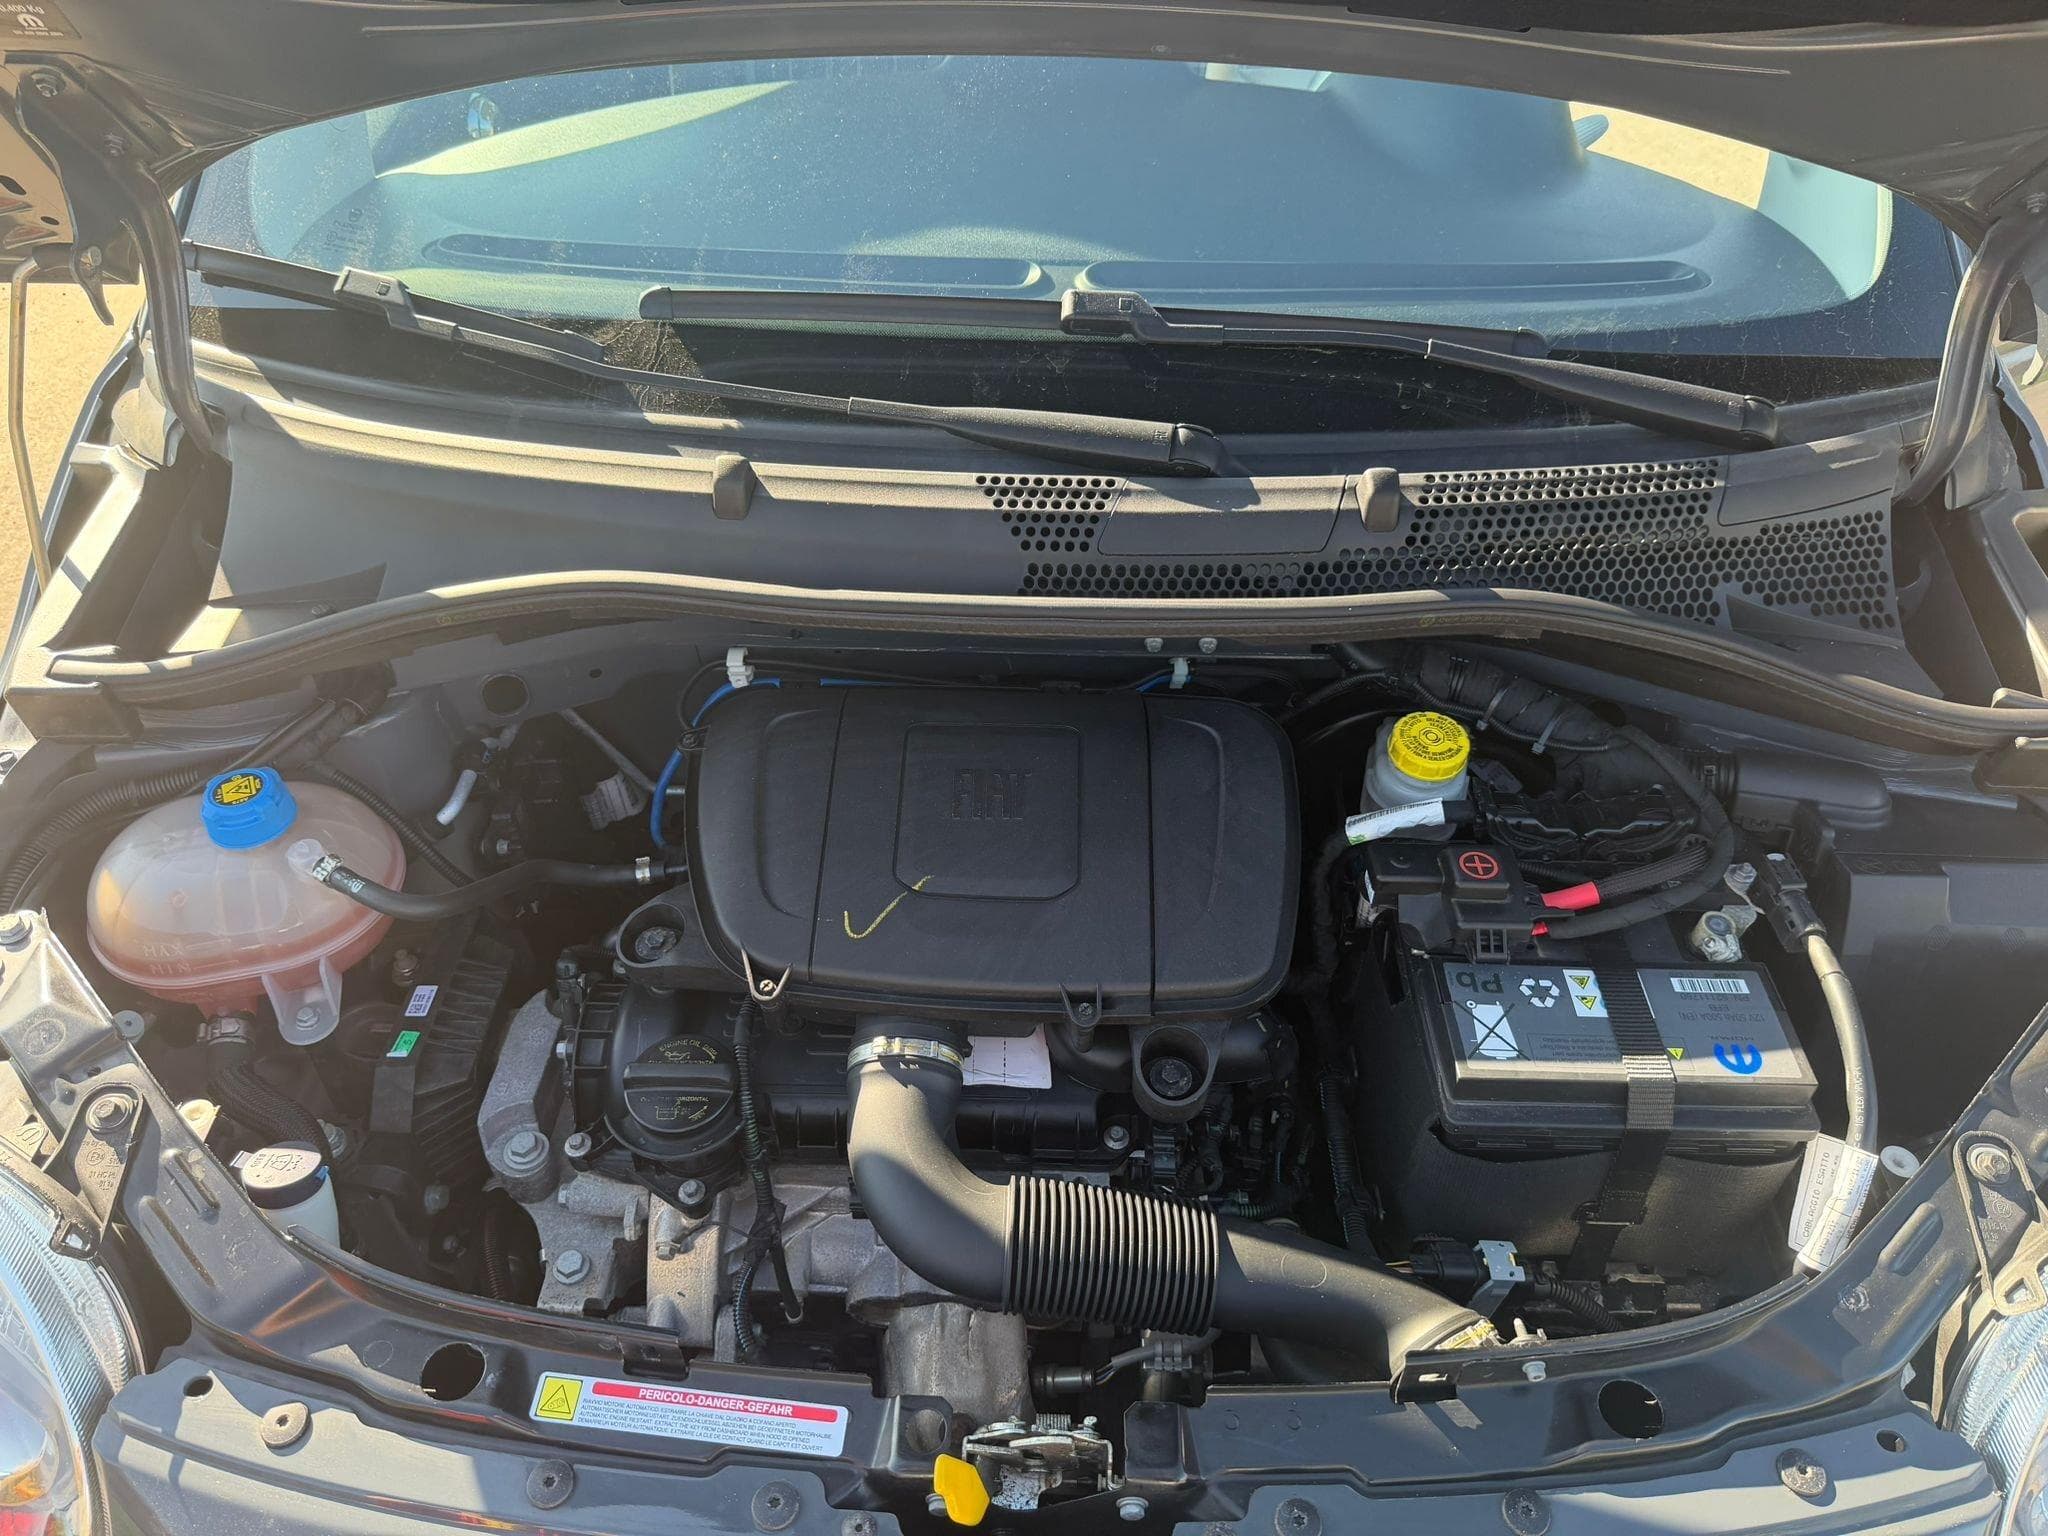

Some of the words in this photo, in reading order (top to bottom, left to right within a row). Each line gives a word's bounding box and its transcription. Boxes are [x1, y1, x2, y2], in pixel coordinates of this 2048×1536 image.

[951, 768, 1032, 820] FIAT
[142, 943, 184, 958] MAX
[150, 961, 192, 976] MIN
[1455, 971, 1504, 994] Pb
[1802, 1189, 1821, 1239] CABLAGGIO
[1816, 1152, 1831, 1186] ESATTO
[638, 1387, 794, 1417] PERICOLO-DANGER-GEFAHR
